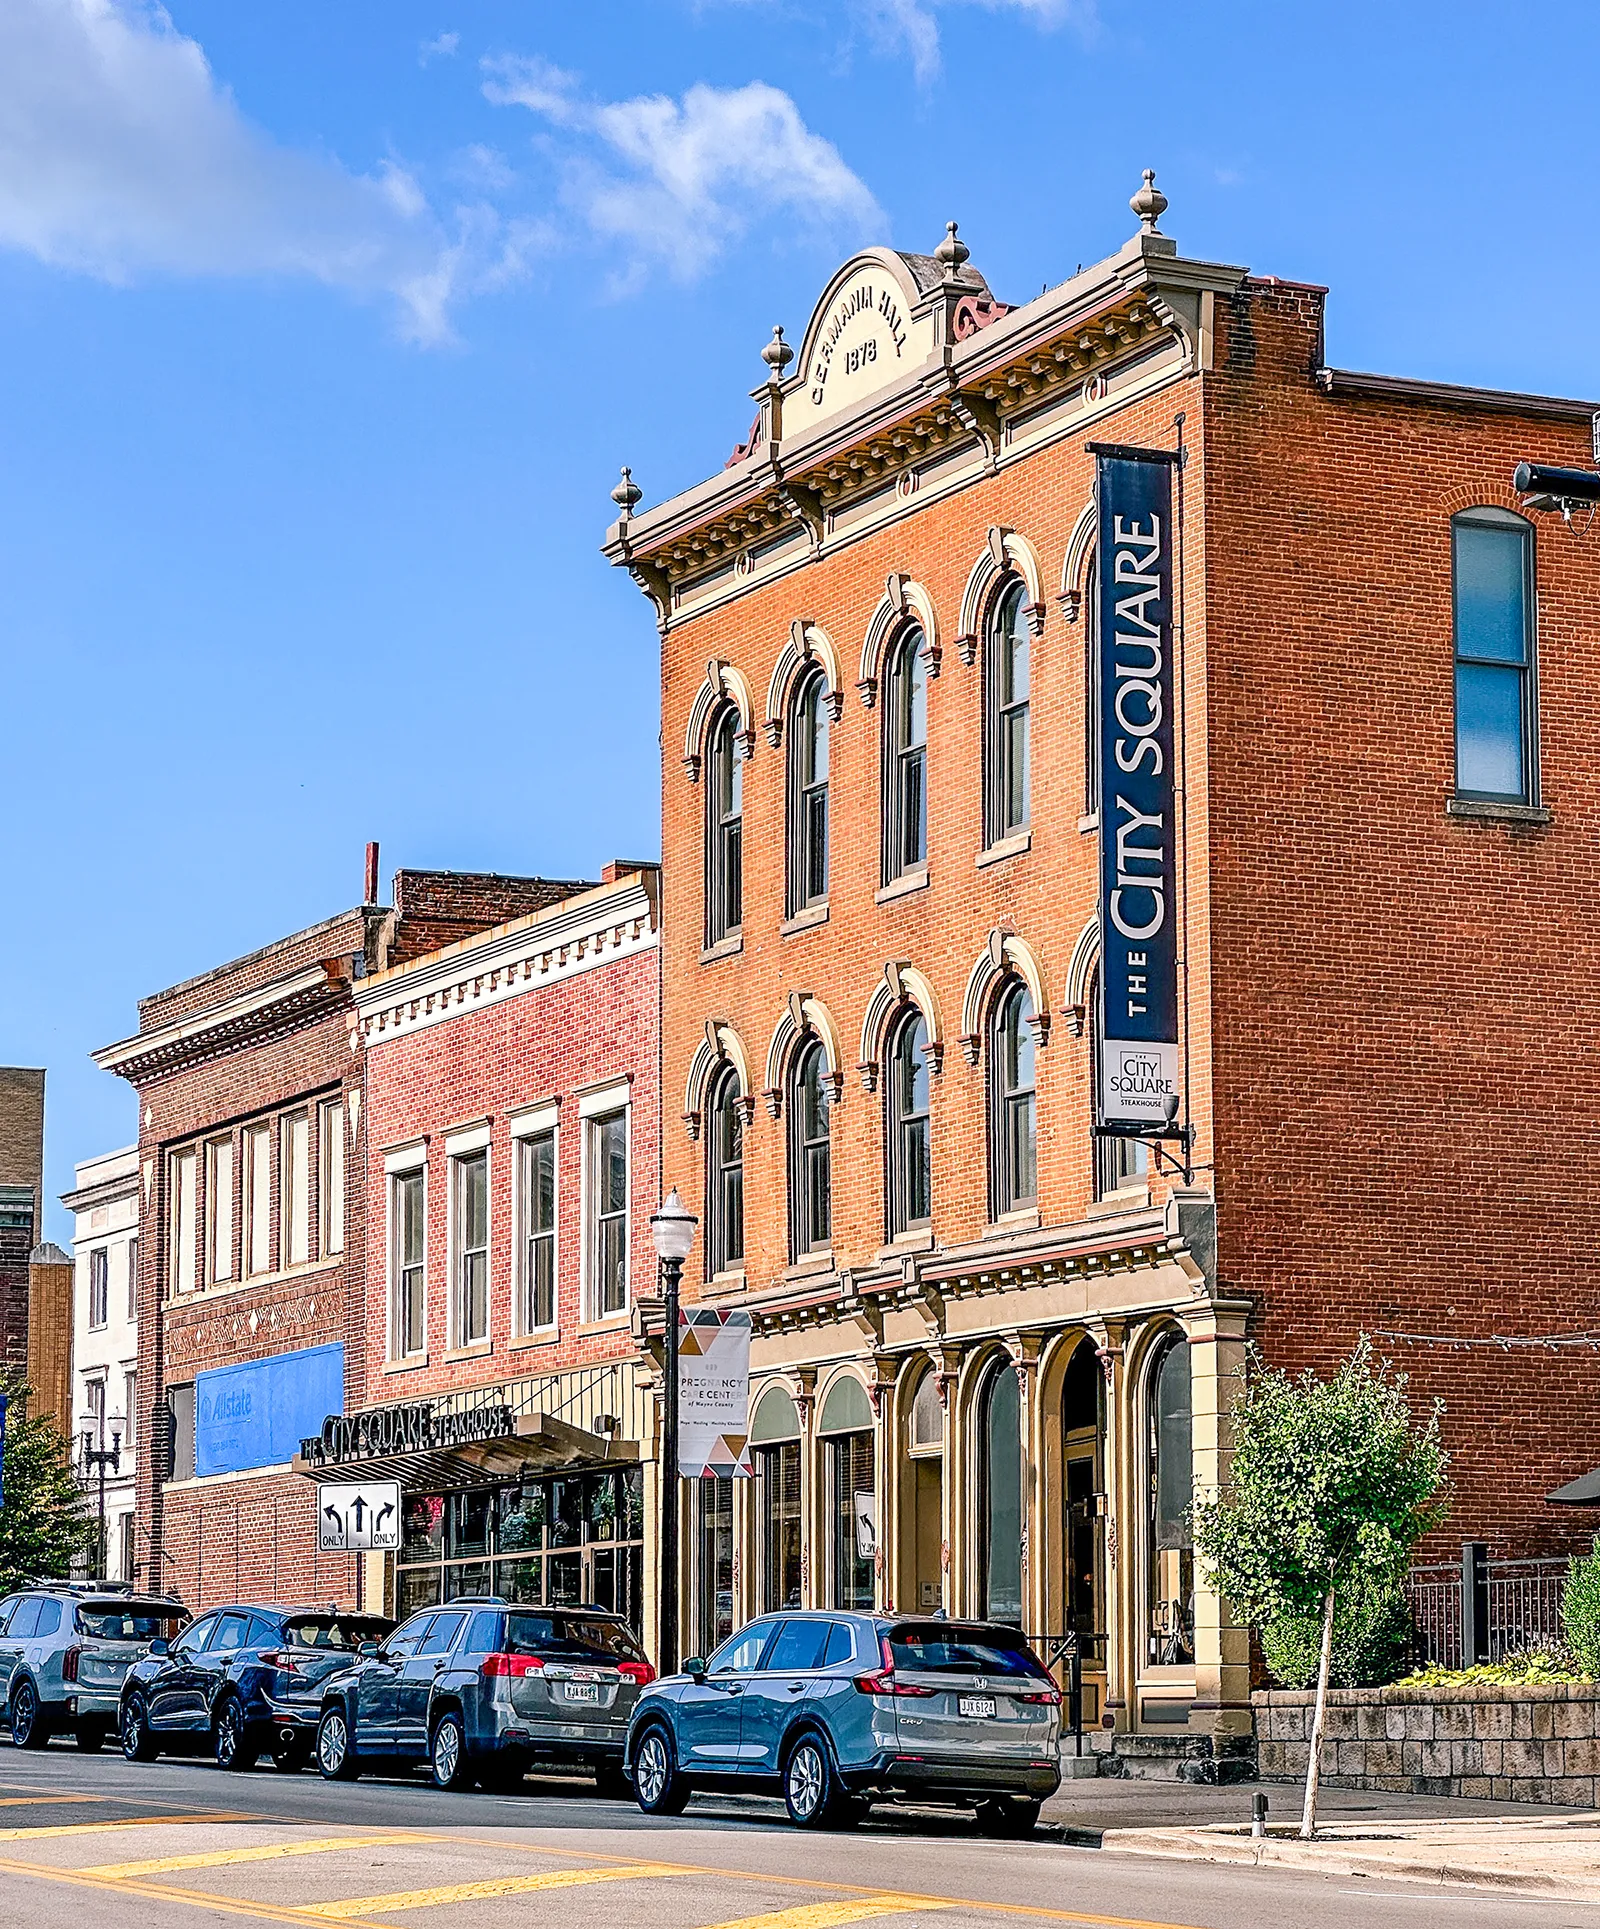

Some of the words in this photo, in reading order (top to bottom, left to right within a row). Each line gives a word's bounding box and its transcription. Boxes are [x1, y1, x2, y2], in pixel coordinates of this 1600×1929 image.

[811, 286, 873, 405] GERMANIA
[878, 290, 906, 358] HALL
[844, 339, 877, 375] 1878
[1114, 512, 1164, 776] SQUARE
[1110, 794, 1164, 940] CITY
[1128, 951, 1148, 1017] THE
[1123, 1059, 1158, 1077] CITY
[1110, 1076, 1174, 1094] SQUARE
[1120, 1099, 1162, 1108] STEAKHOUSE
[681, 1378, 743, 1388] PREGNANCY
[680, 1390, 704, 1399] CARE
[706, 1390, 743, 1400] CENTER
[211, 1388, 252, 1421] Allstate
[299, 1438, 321, 1459] THE
[321, 1414, 356, 1460] CITY
[358, 1404, 430, 1450] SQUARE
[430, 1405, 506, 1441] STEAKHOUSE
[322, 1534, 345, 1546] ONLY
[373, 1533, 396, 1544] ONLY
[573, 1671, 595, 1680] GMC
[961, 1700, 975, 1712] JJX
[976, 1701, 994, 1713] 6124
